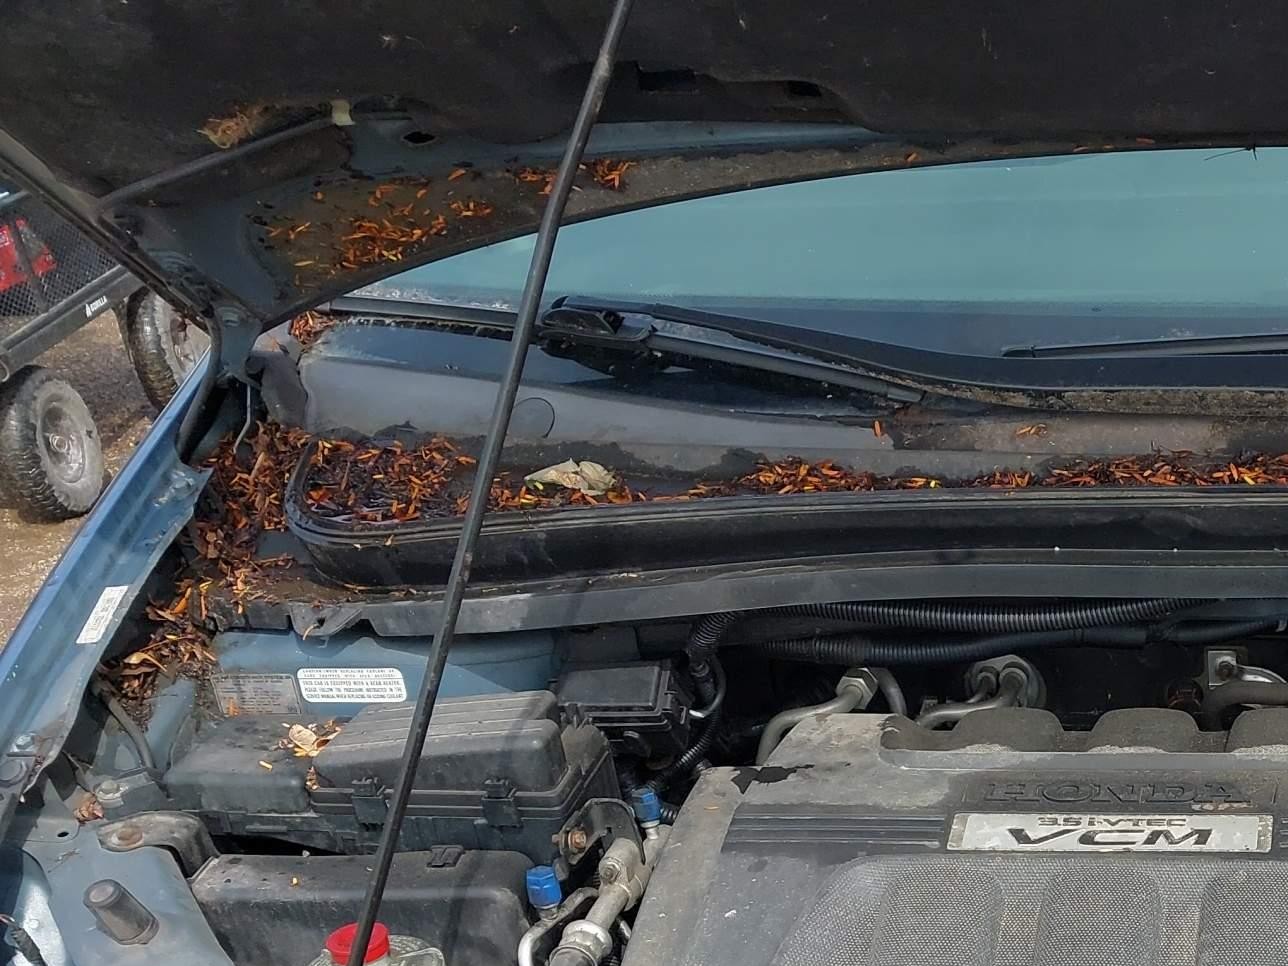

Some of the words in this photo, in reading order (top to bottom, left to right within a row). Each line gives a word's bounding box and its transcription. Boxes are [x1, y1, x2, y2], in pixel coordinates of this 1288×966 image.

[90, 295, 108, 312] GORILLA
[983, 782, 1253, 804] HONDA
[1008, 828, 1213, 847] VCM
